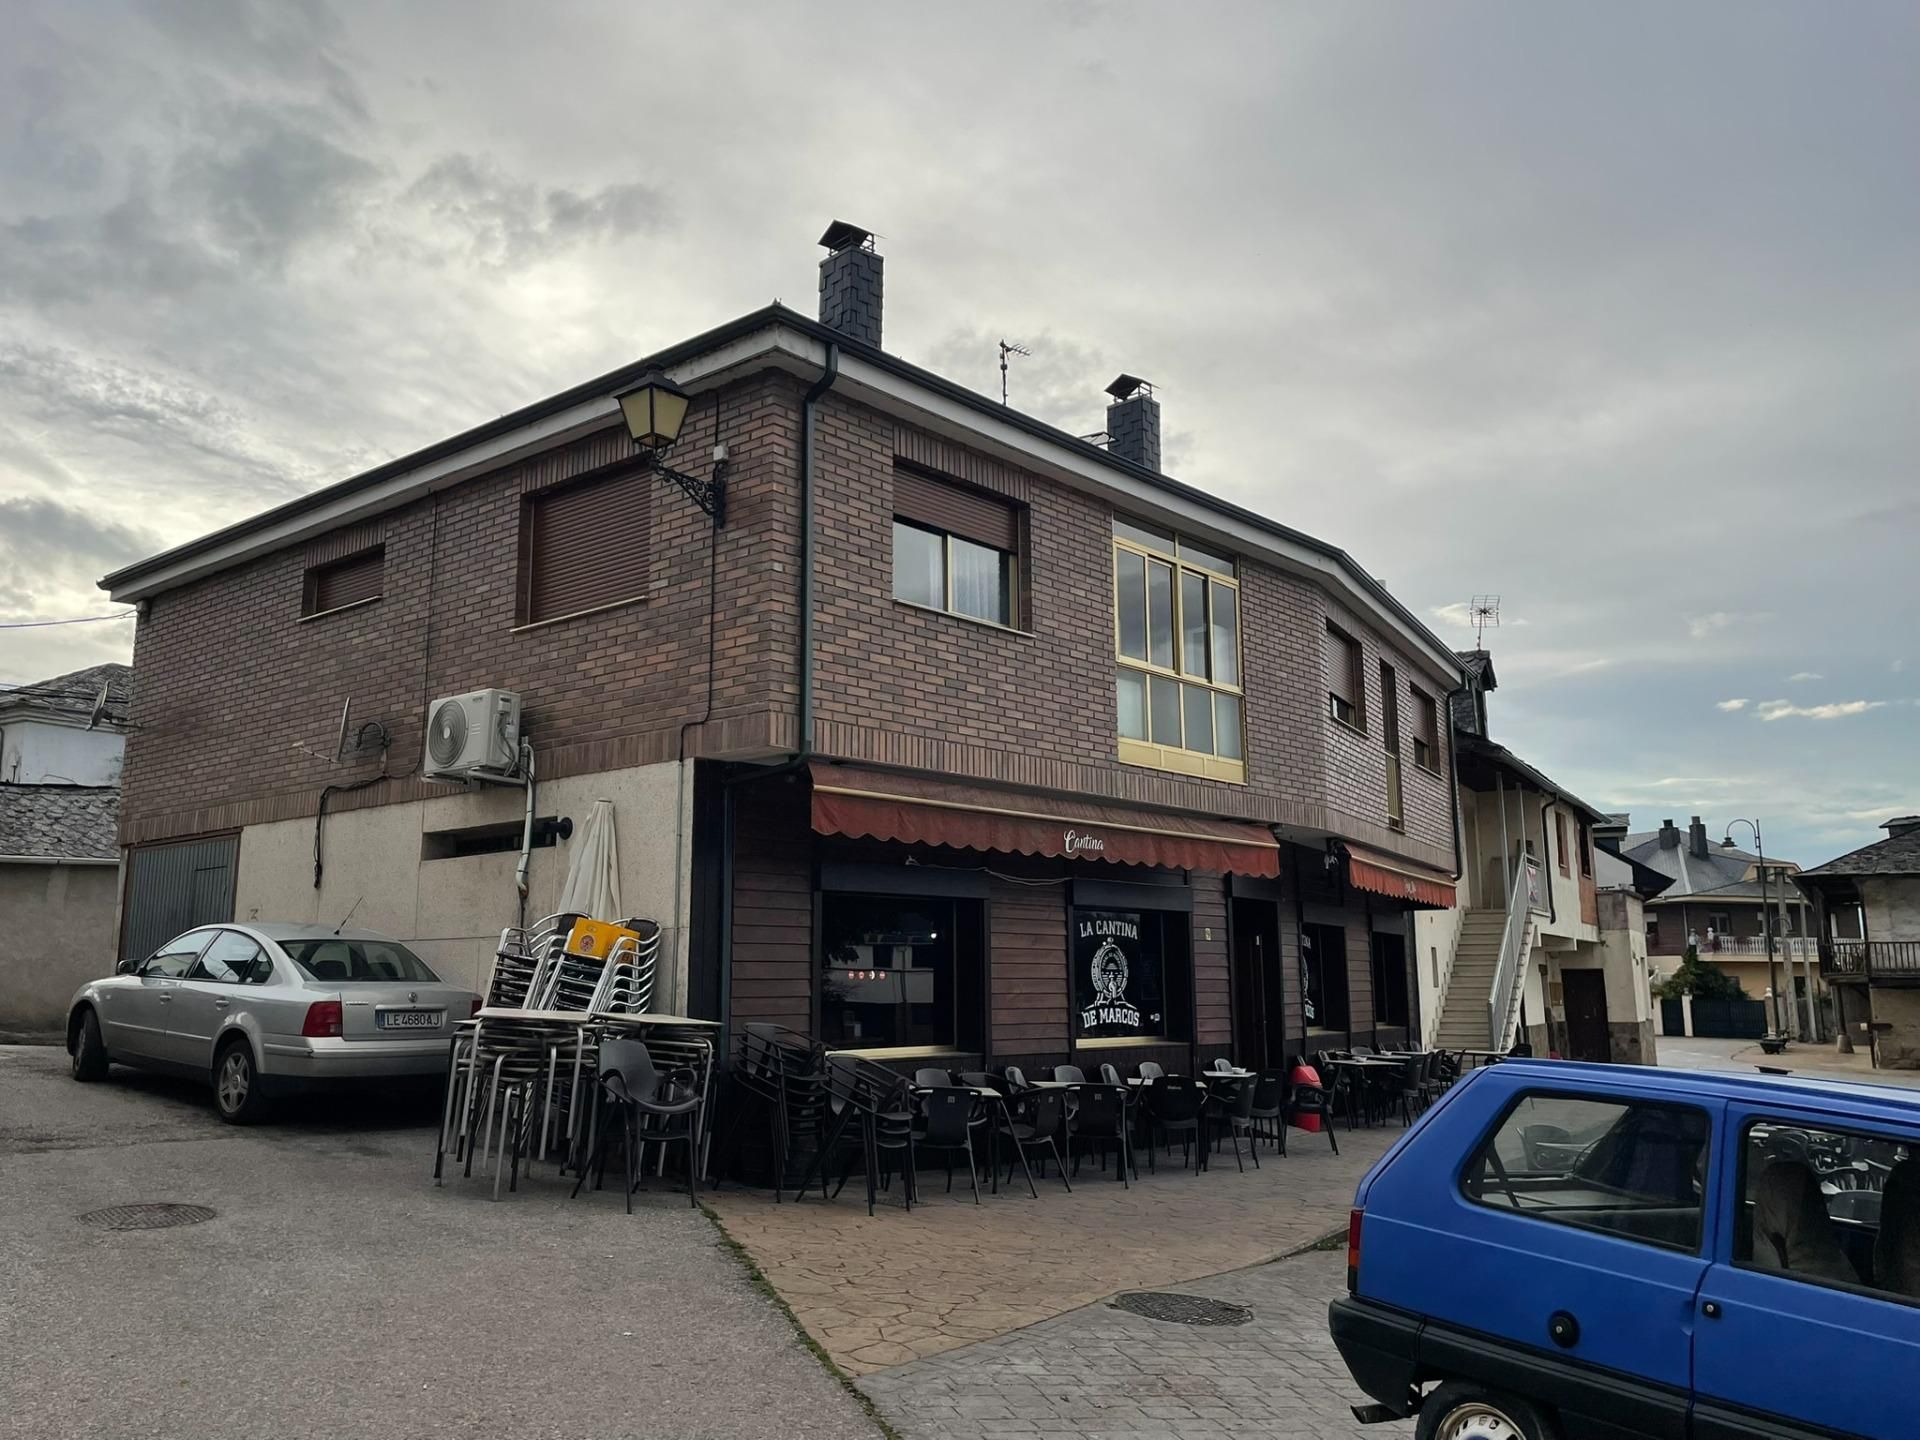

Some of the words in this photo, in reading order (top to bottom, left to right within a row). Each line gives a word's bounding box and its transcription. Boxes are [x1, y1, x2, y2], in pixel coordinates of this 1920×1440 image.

[1064, 830, 1104, 853] Cantina
[1080, 921, 1093, 938] LA
[1096, 920, 1138, 940] CANTINA
[1081, 1010, 1097, 1028] DE
[1099, 1008, 1140, 1027] MARCOS
